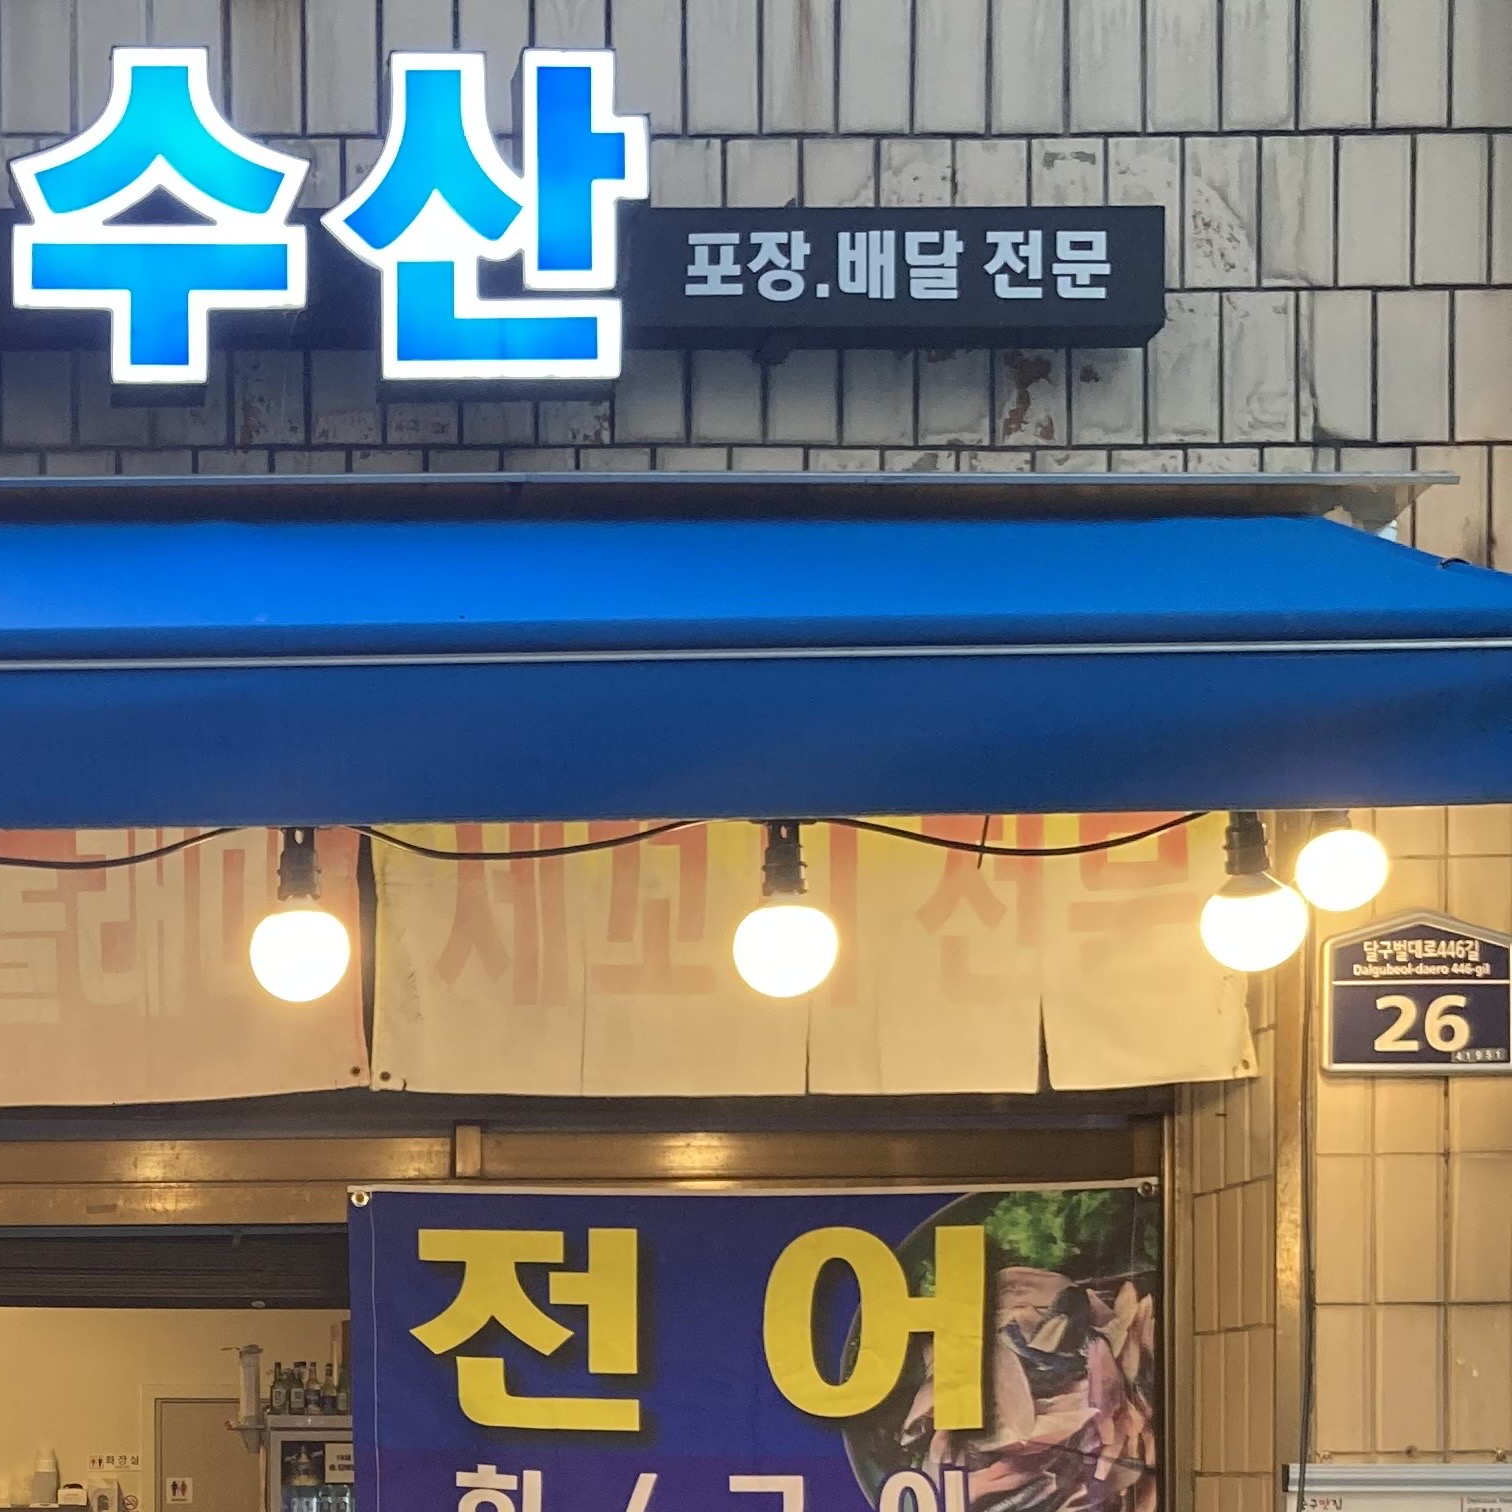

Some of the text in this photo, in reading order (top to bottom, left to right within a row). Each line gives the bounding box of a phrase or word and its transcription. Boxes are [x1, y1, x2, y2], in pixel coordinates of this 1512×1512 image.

[10, 46, 649, 384] 수산
[684, 229, 1112, 301] 포장.배달 전문
[1353, 962, 1492, 978] Dalgubeol-daero 446-gil
[1363, 939, 1481, 962] 달구벌대로446길
[1374, 994, 1471, 1053] 26
[105, 1454, 140, 1466] 화장실
